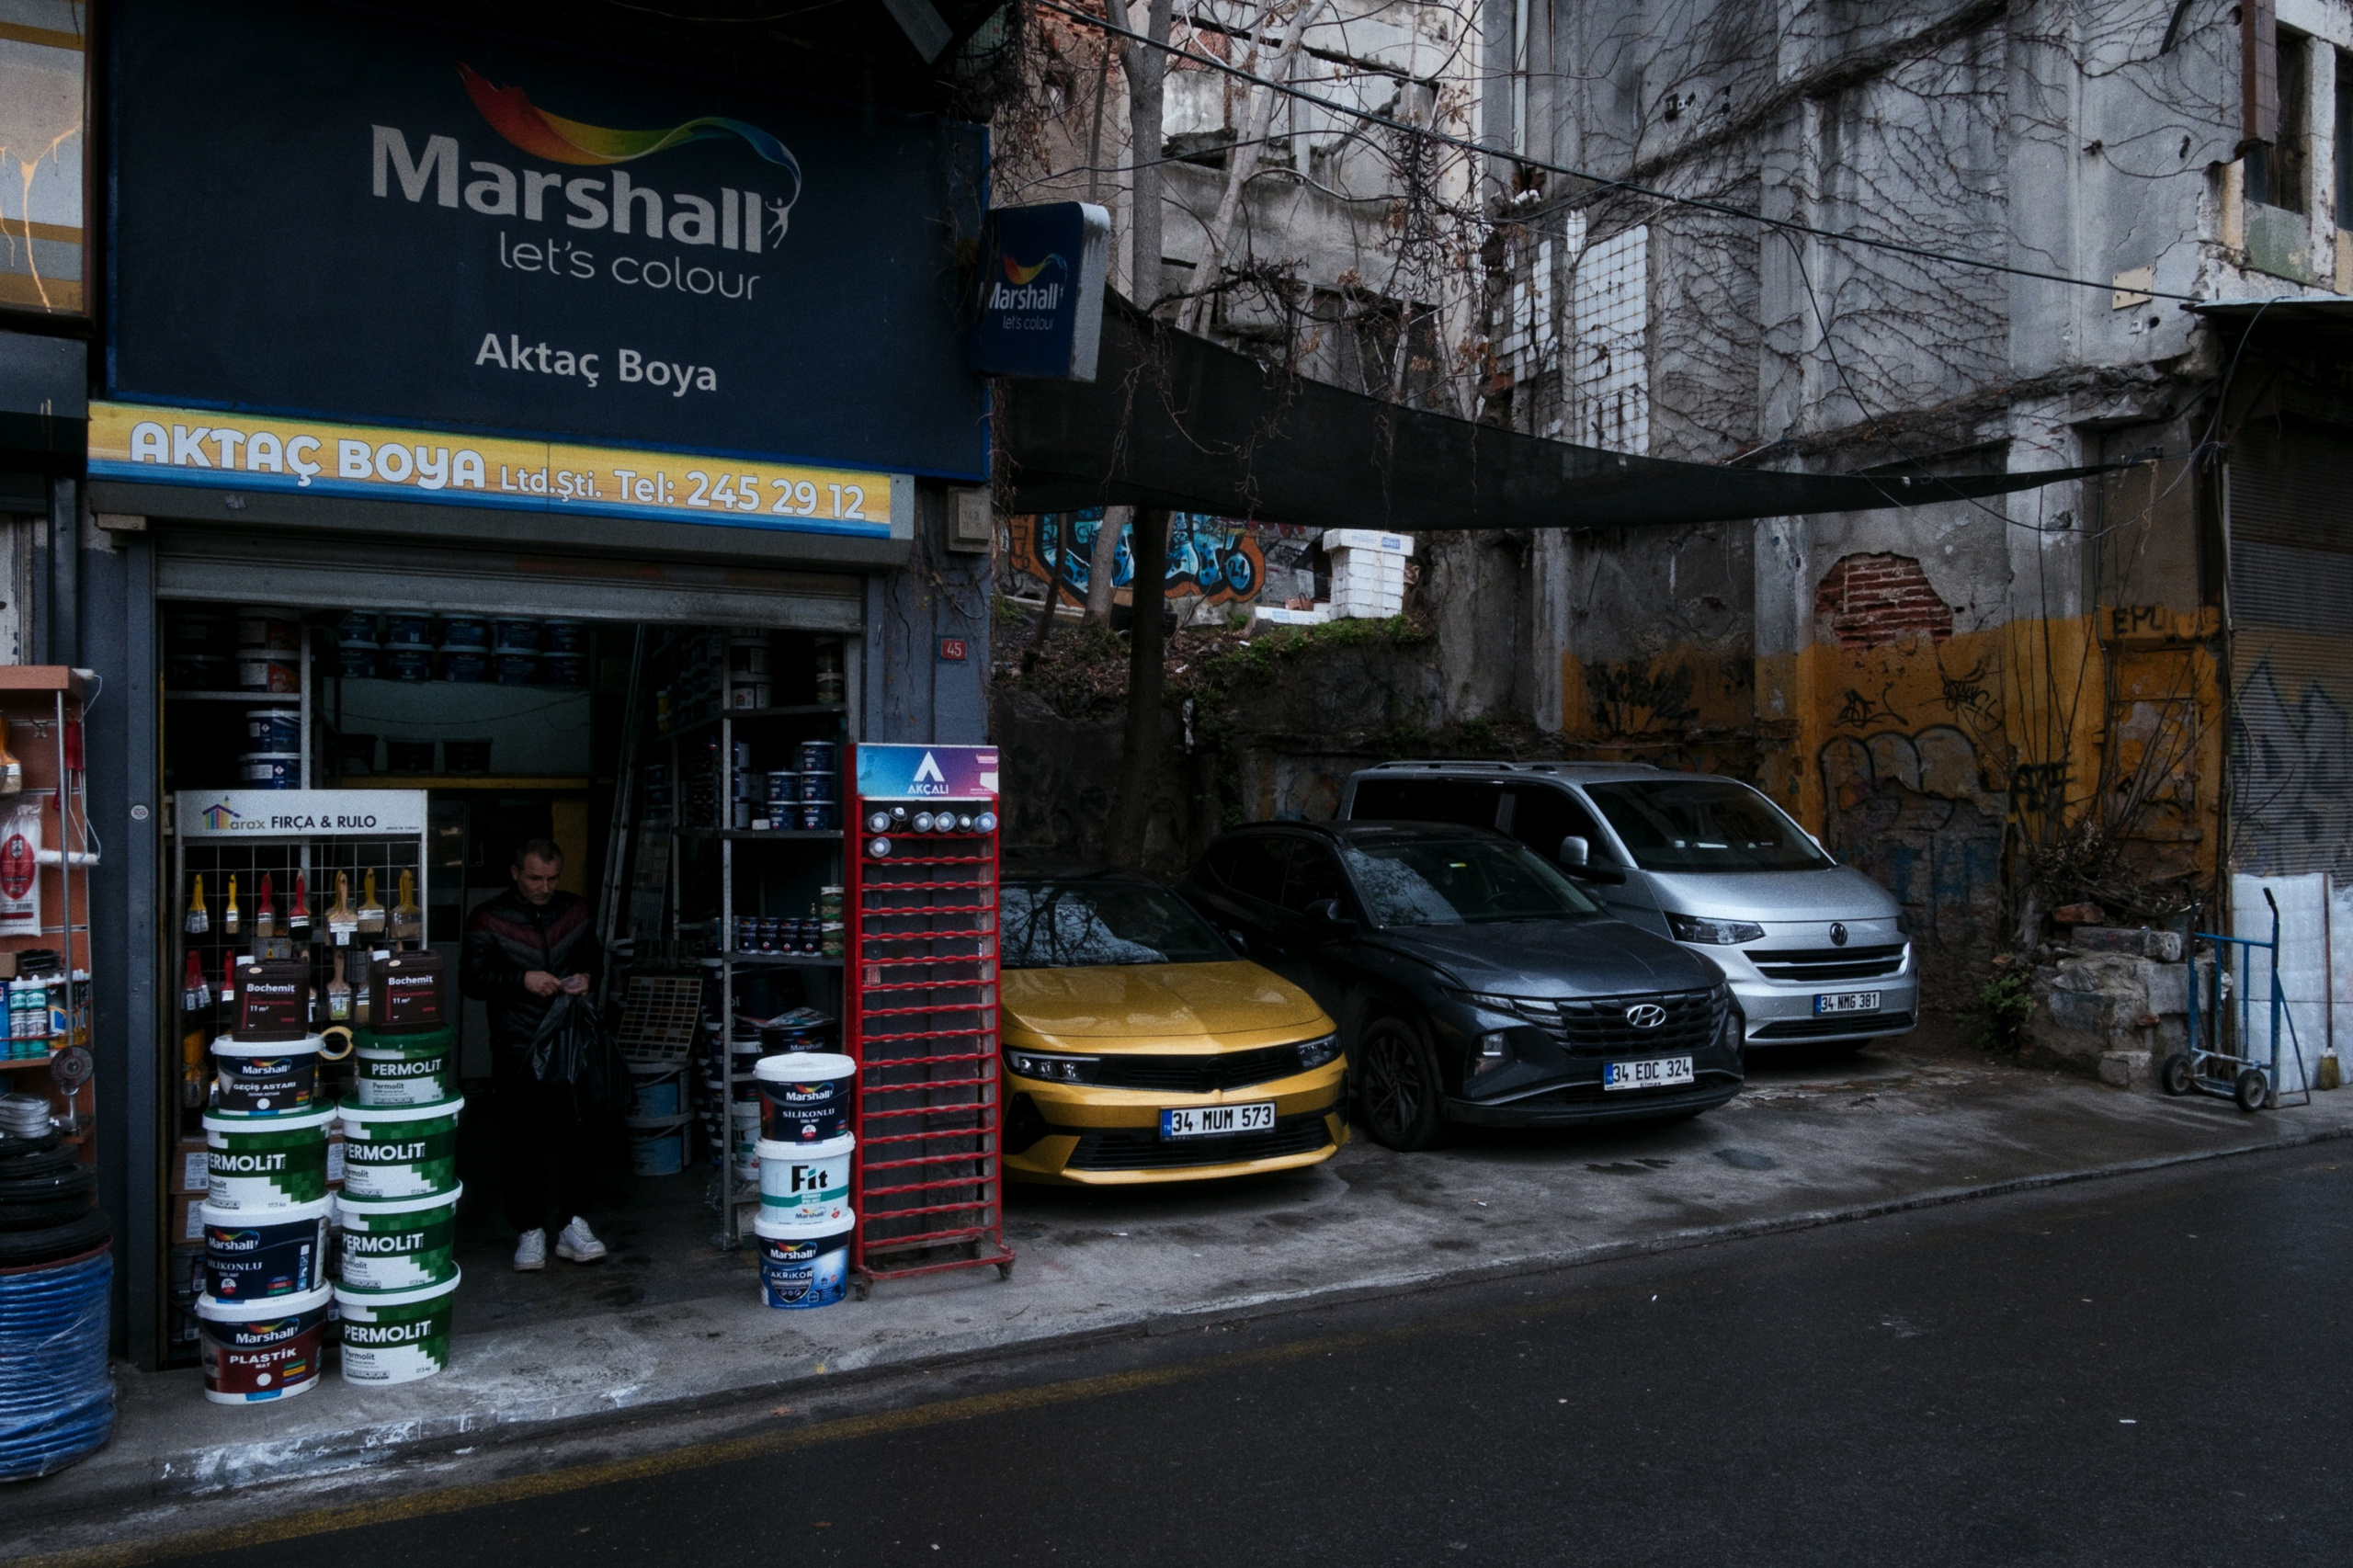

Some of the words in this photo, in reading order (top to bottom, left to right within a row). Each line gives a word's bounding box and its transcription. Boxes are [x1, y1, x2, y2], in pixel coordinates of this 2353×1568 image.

[371, 122, 762, 254] Marshall
[499, 231, 596, 279] let's
[611, 256, 760, 301] colour
[977, 281, 1058, 311] Marshall
[1003, 314, 1022, 330] let's
[1023, 315, 1054, 331] colour
[474, 332, 599, 388] Aktaç
[618, 348, 718, 397] Boya
[131, 421, 323, 487] AKTAÇ
[337, 438, 485, 491] BOYA
[499, 464, 603, 503] Ltd.Şti.
[613, 469, 676, 506] Tel:
[686, 470, 761, 511] 245
[771, 478, 818, 516] 29
[827, 483, 866, 520] 12
[947, 642, 962, 656] 45
[906, 784, 949, 795] AKÇALI
[270, 815, 315, 832] FIRÇA
[320, 814, 333, 828] &
[337, 815, 377, 828] RULO
[388, 974, 434, 985] Bochemit
[246, 983, 296, 993] Bochemit
[1822, 996, 1834, 1011] 34
[1837, 994, 1856, 1010] NMG
[1859, 994, 1877, 1007] 381
[790, 1041, 824, 1051] Marshall
[242, 1063, 289, 1075] Marshall
[1613, 1064, 1629, 1083] 34
[1636, 1062, 1660, 1080] EDC
[1666, 1059, 1689, 1077] 324
[233, 1082, 259, 1092] GEÇİŞ
[261, 1081, 296, 1091] ASTARI
[372, 1082, 404, 1090] Permolit
[785, 1090, 831, 1102] Marshall
[782, 1108, 835, 1119] SİLİKONLU
[1172, 1111, 1193, 1132] 34
[1202, 1108, 1233, 1131] MUM
[1242, 1106, 1271, 1127] 573
[791, 1165, 828, 1193] Fit
[795, 1210, 824, 1220] Marshall
[208, 1236, 255, 1251] Marshall
[769, 1248, 813, 1260] Marshall
[235, 1326, 294, 1344] Marshall
[229, 1346, 297, 1364] PLASTİK
[346, 1348, 375, 1360] Permolit
